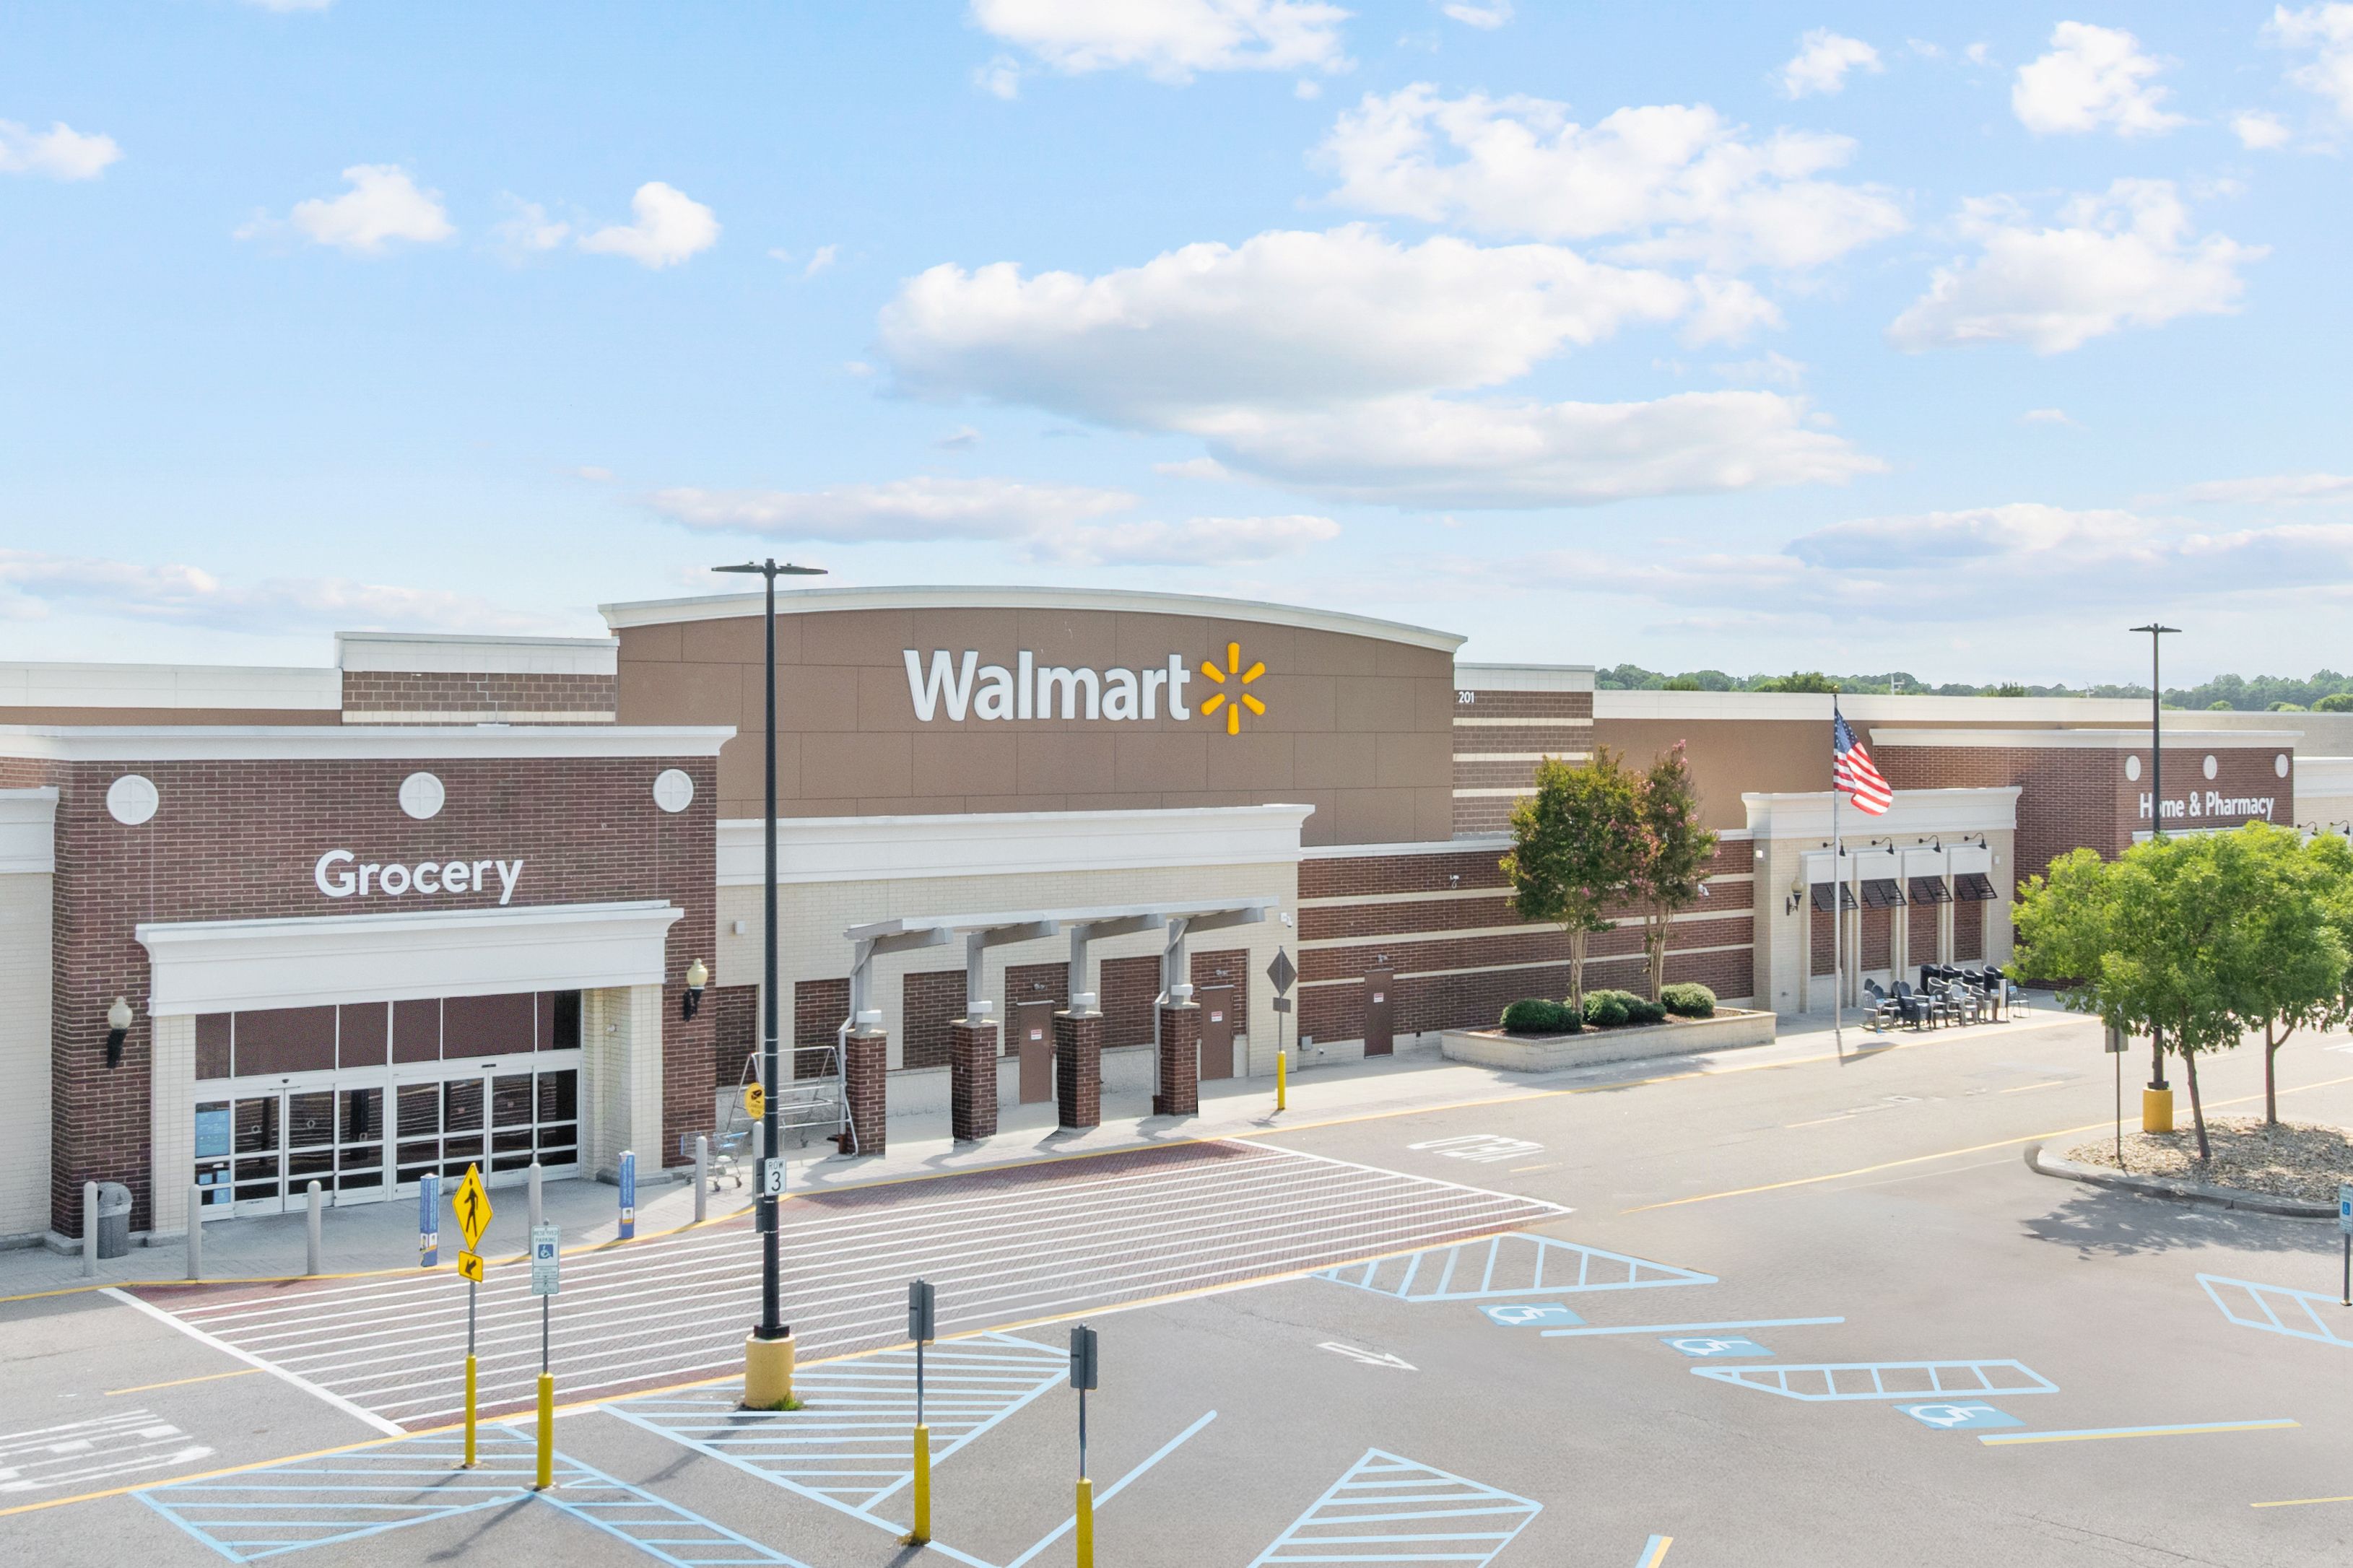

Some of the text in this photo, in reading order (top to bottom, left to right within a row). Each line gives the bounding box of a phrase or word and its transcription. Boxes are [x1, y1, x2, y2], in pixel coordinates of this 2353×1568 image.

[903, 649, 1191, 723] Walmart
[1458, 691, 1474, 703] 201
[2139, 791, 2274, 821] Hme & Pharmacy
[314, 849, 524, 905] Grocery
[768, 1161, 784, 1170] ROW
[771, 1171, 781, 1192] 3
